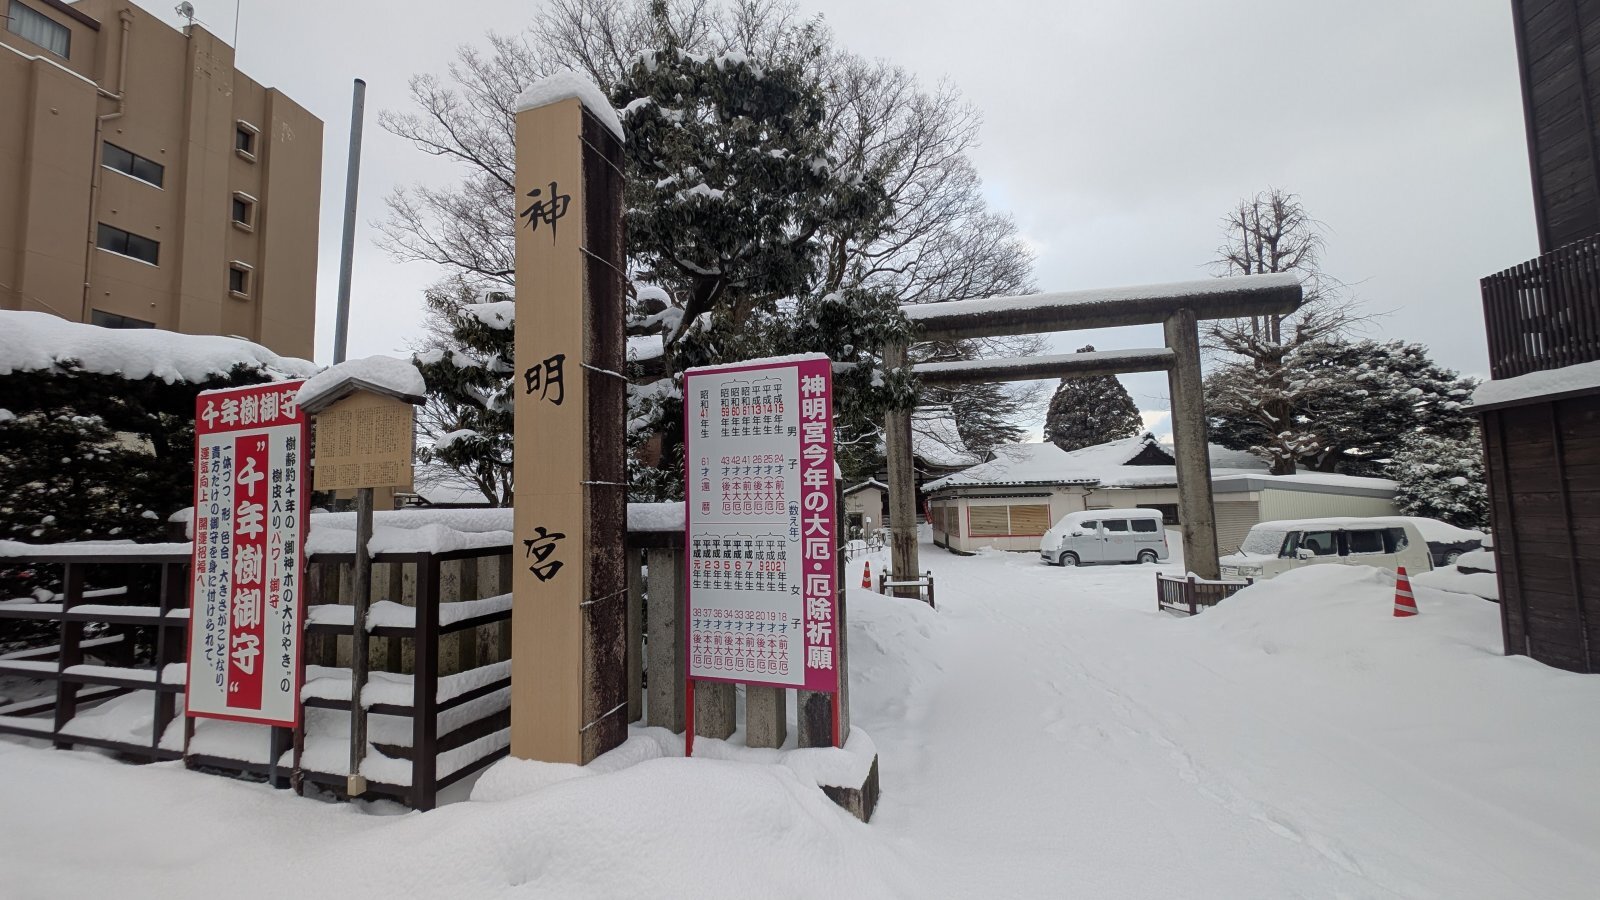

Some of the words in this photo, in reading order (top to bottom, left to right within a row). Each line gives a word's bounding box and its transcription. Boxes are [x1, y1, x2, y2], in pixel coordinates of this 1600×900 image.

[519, 181, 571, 583] 神明宮
[202, 390, 299, 429] 千年樹御守
[720, 388, 730, 437] 昭和59年生
[730, 387, 740, 437] 昭和60年生
[751, 385, 762, 436] 平成13年生
[762, 384, 773, 435] 平成14年生
[773, 383, 784, 435] 平成15年生
[788, 500, 800, 543] （数え年）
[801, 374, 833, 671] 神明宮今年の大厄・厄除祈願
[702, 540, 711, 589] 平成2年生
[712, 540, 721, 590] 平成3年生
[723, 540, 732, 590] 平成5年生
[733, 540, 743, 591] 平成6年生
[744, 540, 754, 591] 平成7年生
